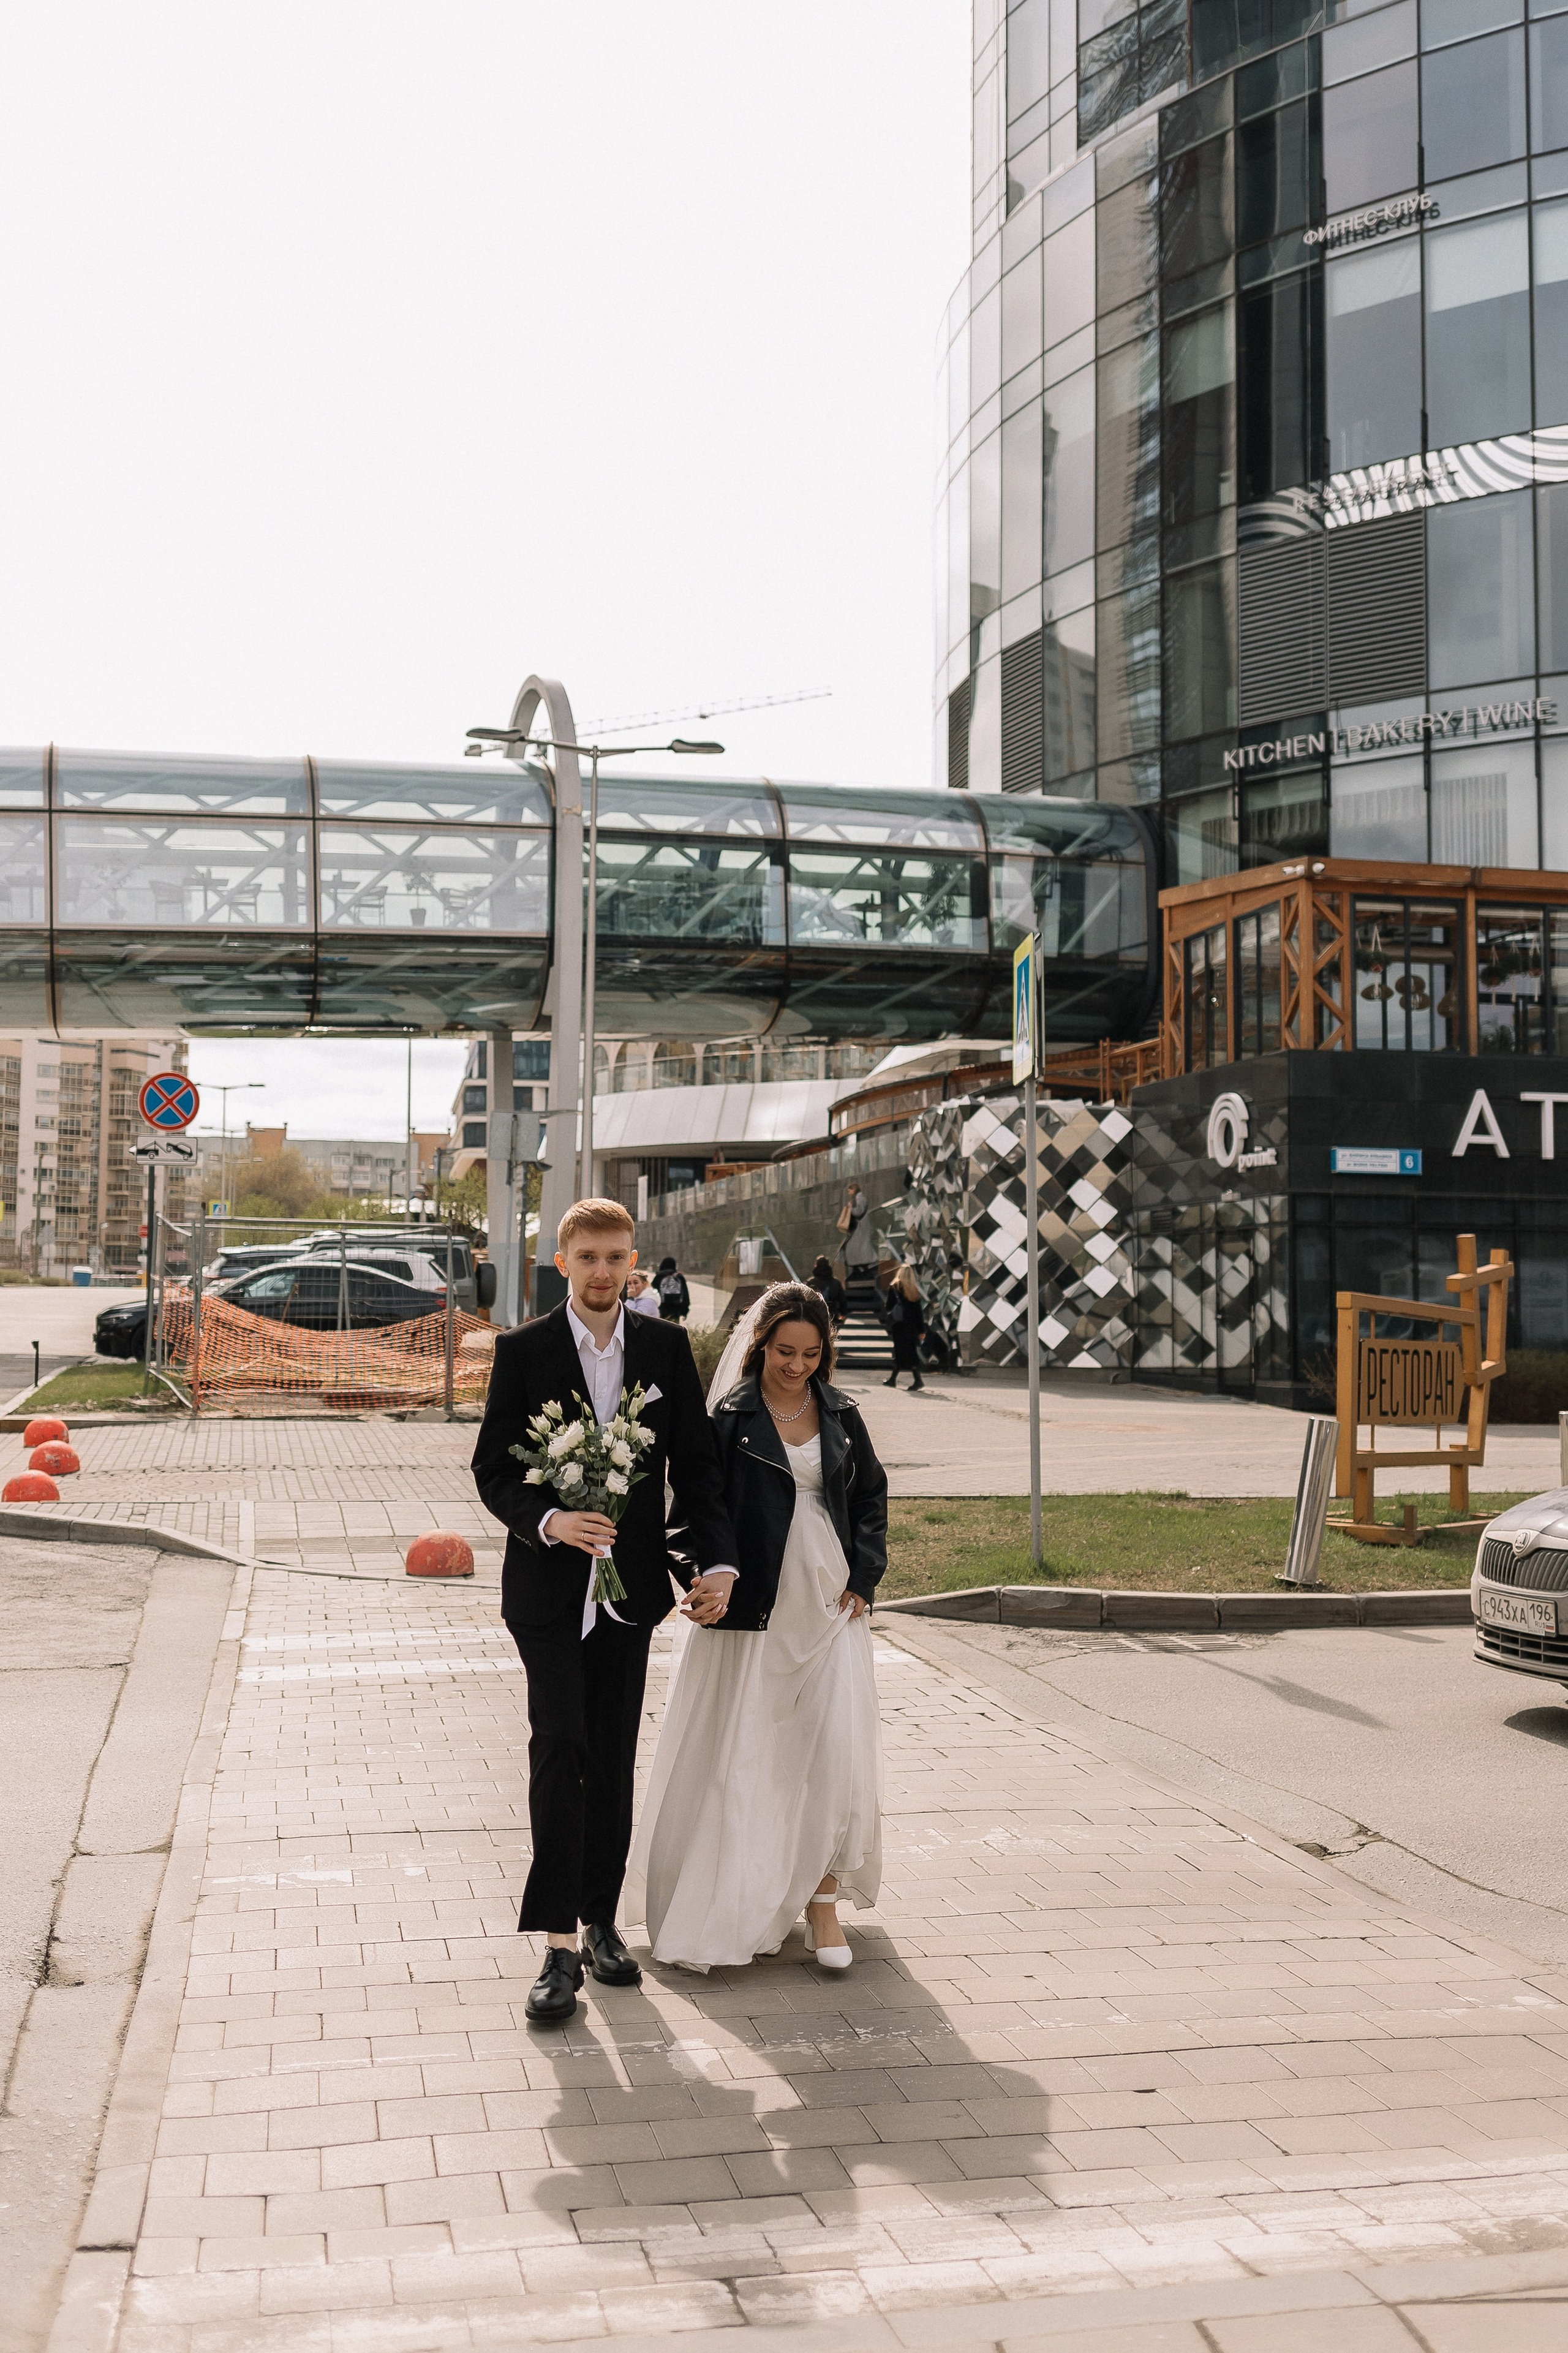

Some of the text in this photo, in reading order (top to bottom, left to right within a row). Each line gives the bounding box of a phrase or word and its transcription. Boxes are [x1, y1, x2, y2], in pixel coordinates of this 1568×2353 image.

[1303, 192, 1432, 245] ФИТНЕС-КЛУБ
[1223, 697, 1553, 771] KITCHEN BAKERY WINE
[1367, 1347, 1455, 1417] РЕСТОРАН
[1529, 1603, 1551, 1622] 196
